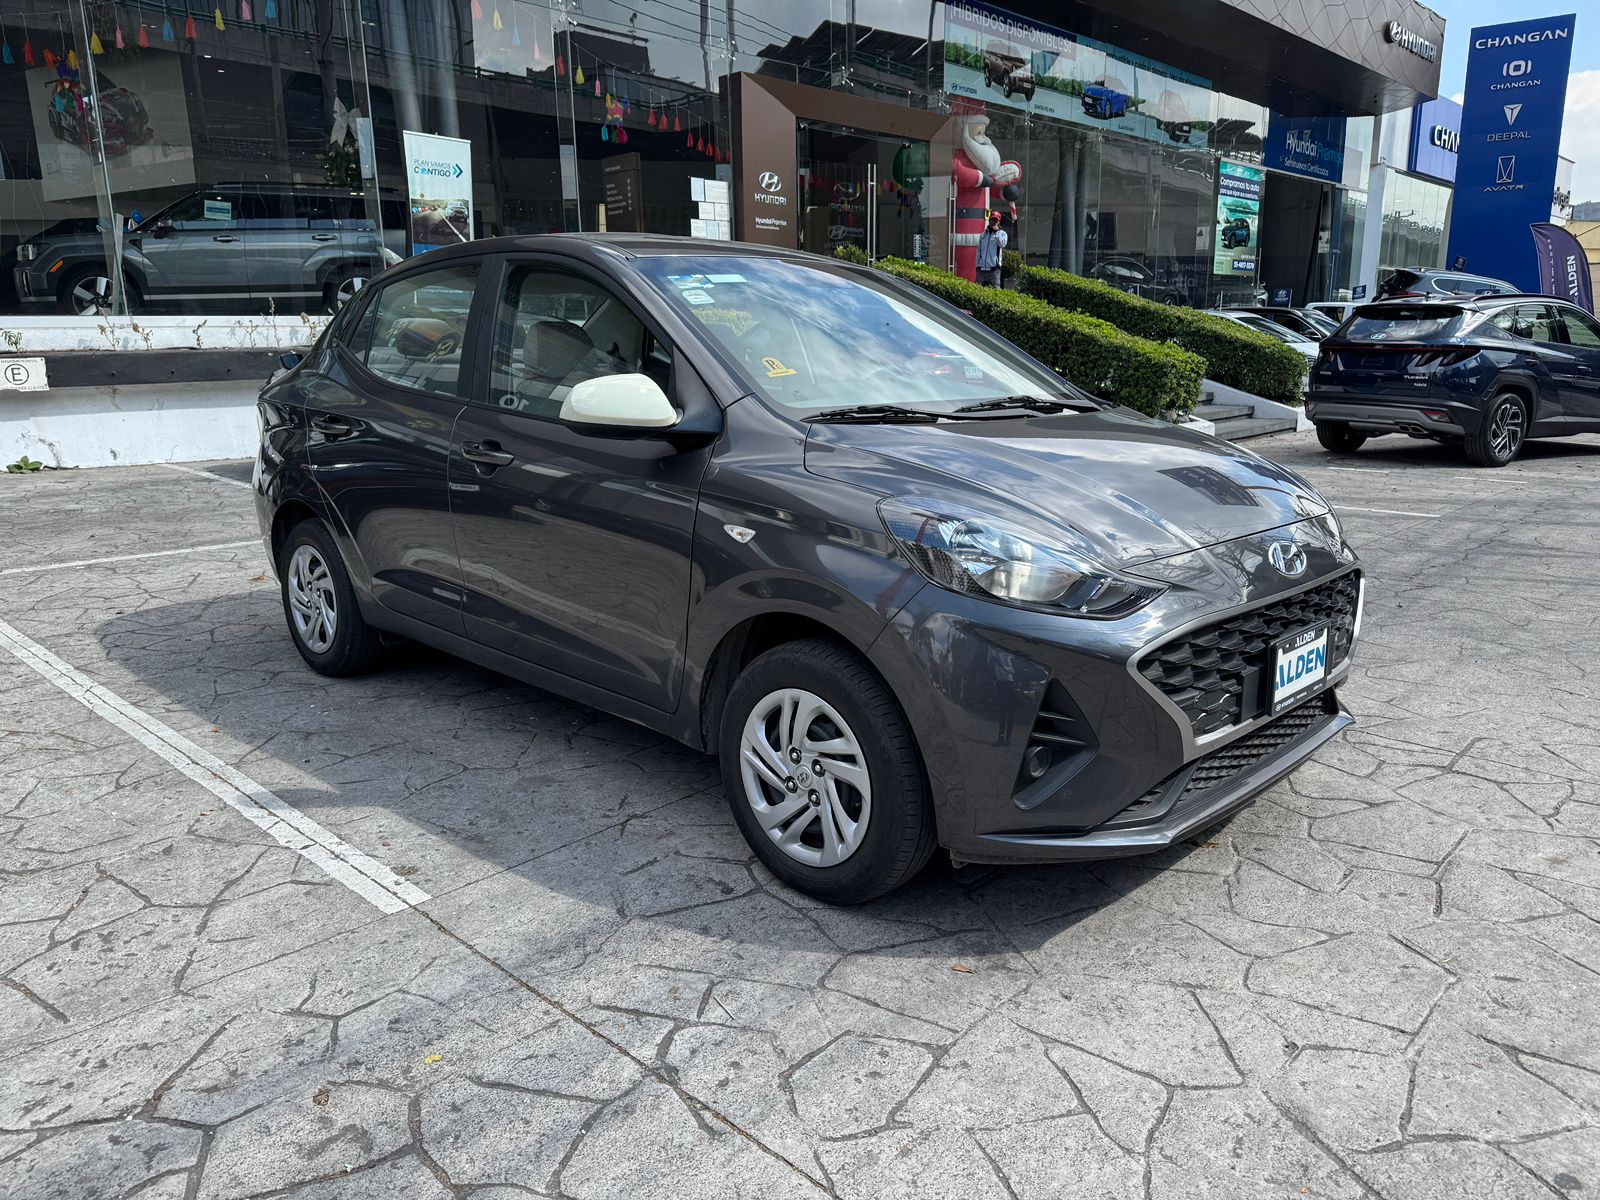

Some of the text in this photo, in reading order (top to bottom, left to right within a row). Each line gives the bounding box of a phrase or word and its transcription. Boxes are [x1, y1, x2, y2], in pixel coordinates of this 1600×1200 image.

[950, 0, 1073, 54] ¡HÍBRIDOS DISPONIBLES!
[1401, 28, 1437, 63] HYUNDAI
[1475, 28, 1568, 49] CHANGAN
[1490, 79, 1541, 91] CHANGAN
[1285, 131, 1318, 156] Hyundai
[1486, 130, 1532, 142] DEEPAL
[430, 160, 451, 169] VAMOS
[1284, 157, 1329, 176] Seminuevos Certificados
[1220, 176, 1246, 189] Compramos
[1250, 183, 1260, 192] auto
[1483, 184, 1525, 192] AVATR
[754, 193, 787, 206] HYUNDAI
[1566, 255, 1579, 297] ALDEN
[11, 367, 22, 381] E
[1294, 630, 1316, 648] ALDEN
[1275, 644, 1327, 691] ALDEN
